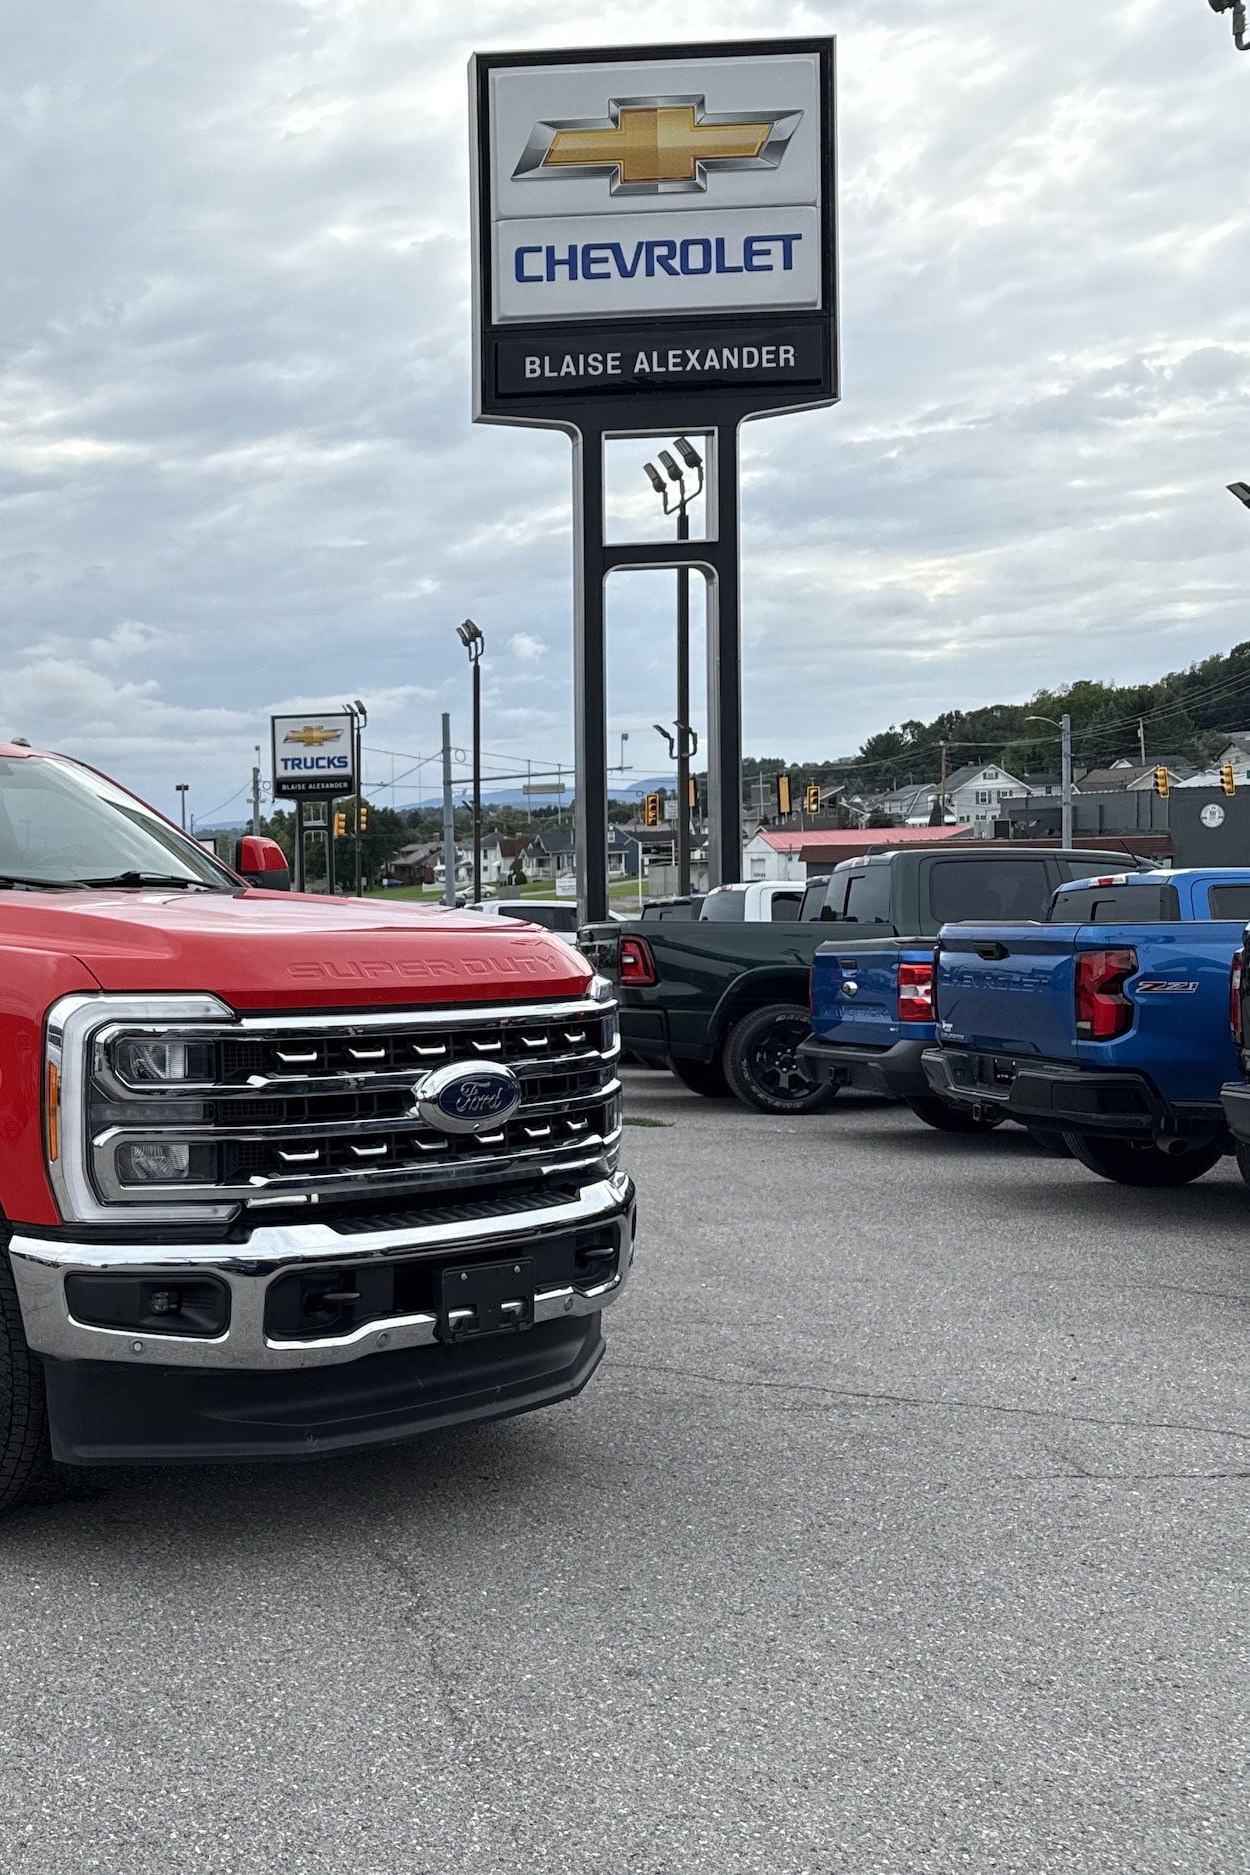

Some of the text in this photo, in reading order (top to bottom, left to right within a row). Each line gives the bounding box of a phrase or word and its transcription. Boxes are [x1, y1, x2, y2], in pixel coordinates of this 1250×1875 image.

[515, 233, 802, 282] CHEVROLET
[525, 345, 795, 378] BLAISE ALEXANDER
[280, 755, 348, 770] TRUCKS
[281, 781, 348, 791] BLAISE ALEXANDER
[287, 955, 556, 980] SUPER DUTY
[1135, 981, 1199, 993] Z71
[456, 1081, 503, 1112] Ford
